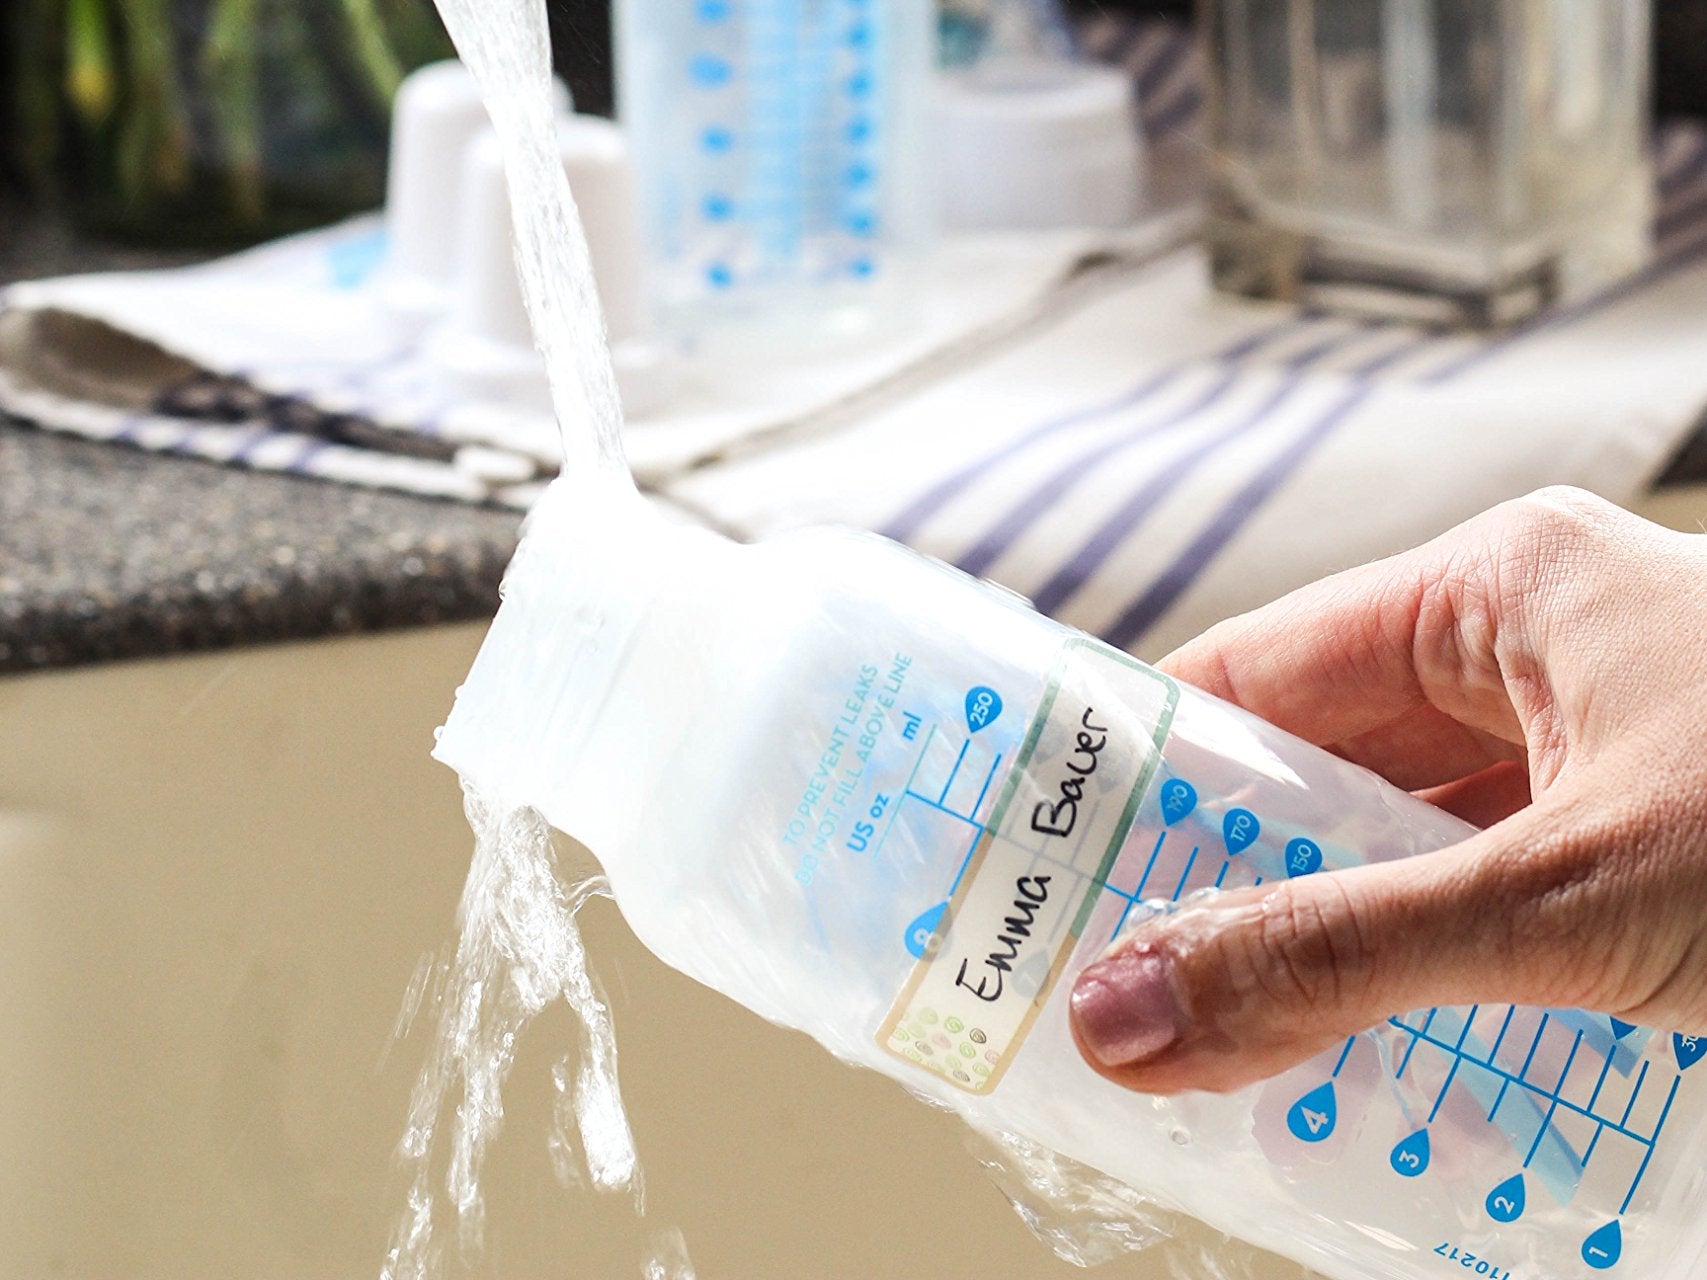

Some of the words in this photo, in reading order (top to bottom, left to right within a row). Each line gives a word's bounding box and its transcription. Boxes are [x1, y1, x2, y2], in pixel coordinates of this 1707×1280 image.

[970, 692, 993, 726] 250
[902, 709, 922, 741] ml
[782, 819, 806, 846] TO
[797, 724, 850, 818] PREVENT
[840, 663, 878, 726] LEAKS
[794, 852, 819, 888] DO
[813, 807, 841, 852] NOT
[832, 768, 863, 808] FILL
[856, 693, 895, 764] ABOVE
[884, 652, 912, 696] LINE
[846, 821, 875, 853] US
[870, 792, 890, 819] oz
[1230, 814, 1252, 842] 170
[955, 876, 1052, 1002] Emma
[1031, 706, 1108, 838] Bauer
[1290, 844, 1312, 872] 150
[913, 927, 943, 953] 8
[1300, 1105, 1329, 1135] 4
[1398, 1149, 1420, 1169] 3
[1494, 1196, 1515, 1215] 2
[1588, 1246, 1609, 1259] 1
